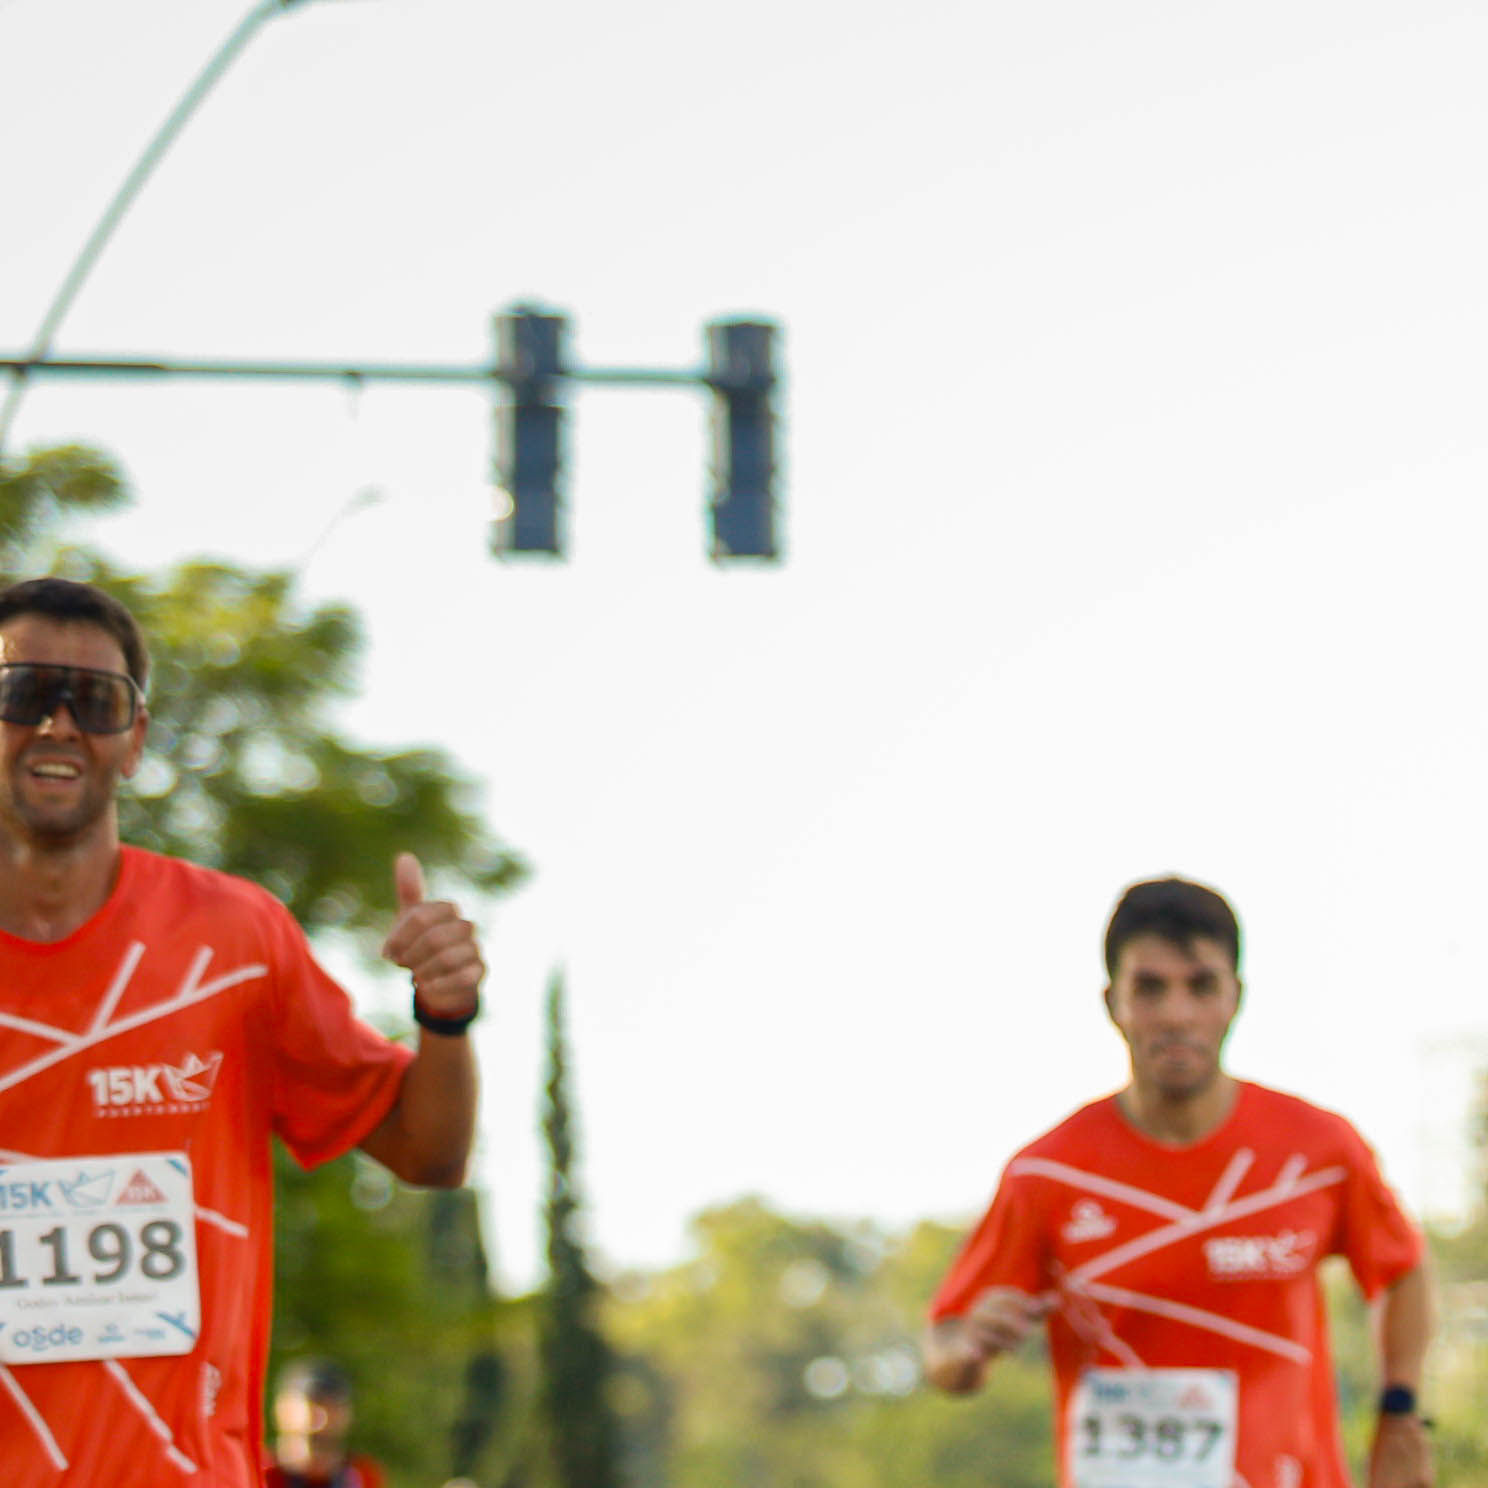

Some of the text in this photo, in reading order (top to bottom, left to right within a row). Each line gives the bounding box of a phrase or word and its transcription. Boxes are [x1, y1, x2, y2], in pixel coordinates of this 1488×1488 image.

[87, 1066, 165, 1106] 15K
[0, 1180, 52, 1209] 15K
[0, 1219, 187, 1289] 1198
[1082, 1413, 1223, 1462] 1387
